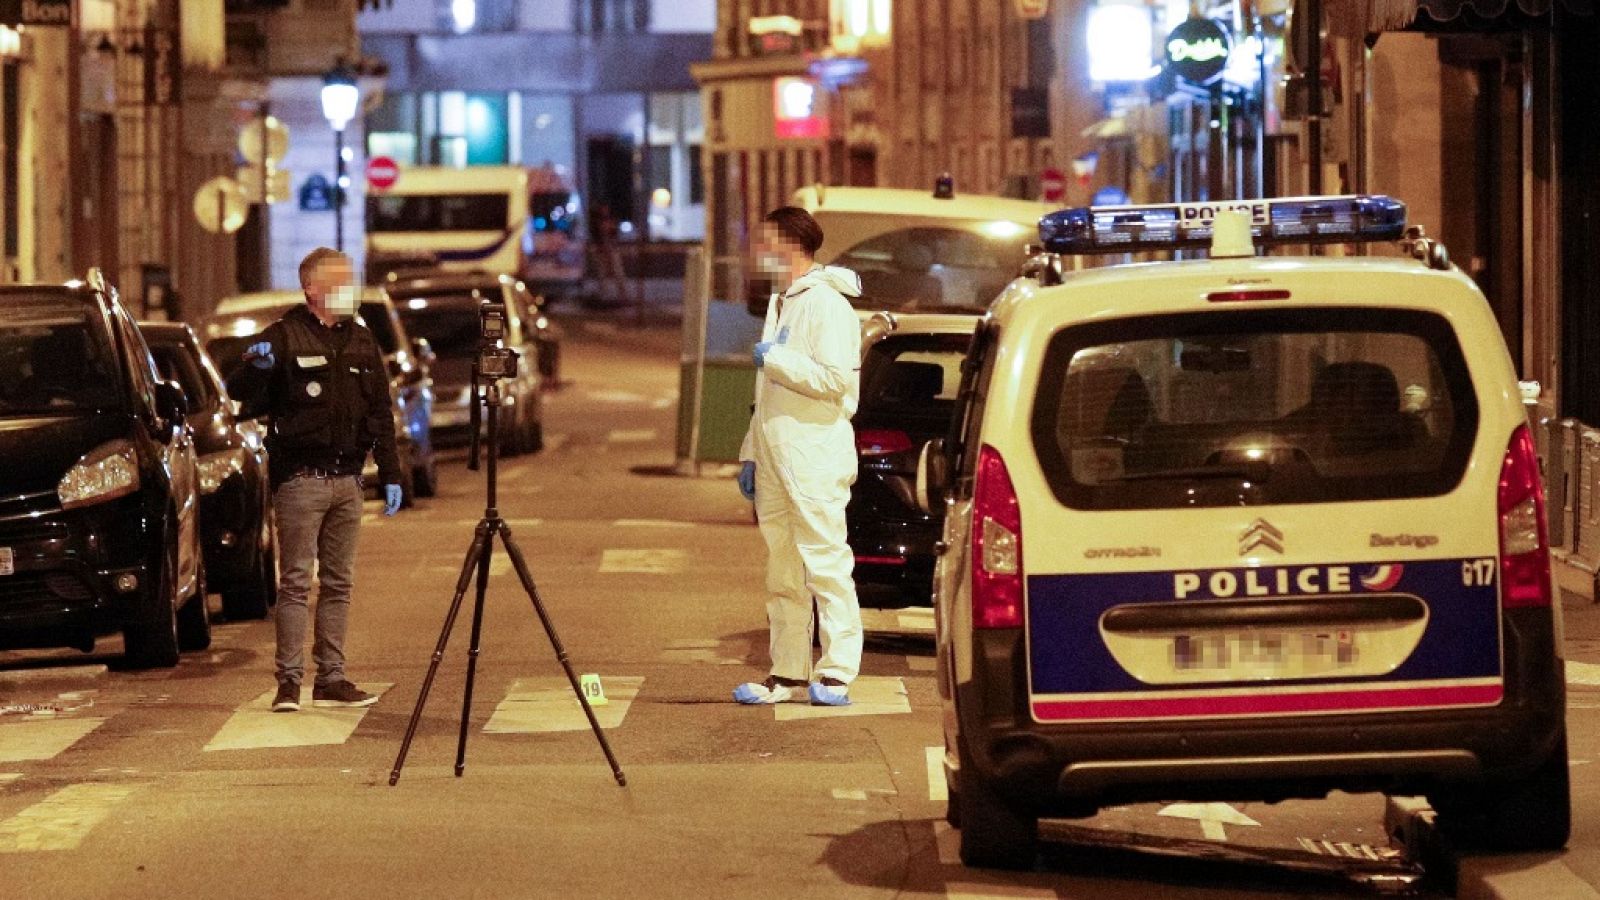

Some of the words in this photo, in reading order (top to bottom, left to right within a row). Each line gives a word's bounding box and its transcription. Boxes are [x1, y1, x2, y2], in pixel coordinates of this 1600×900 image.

[1184, 204, 1266, 226] POE
[1174, 566, 1351, 600] POLICE
[583, 682, 601, 698] 19
